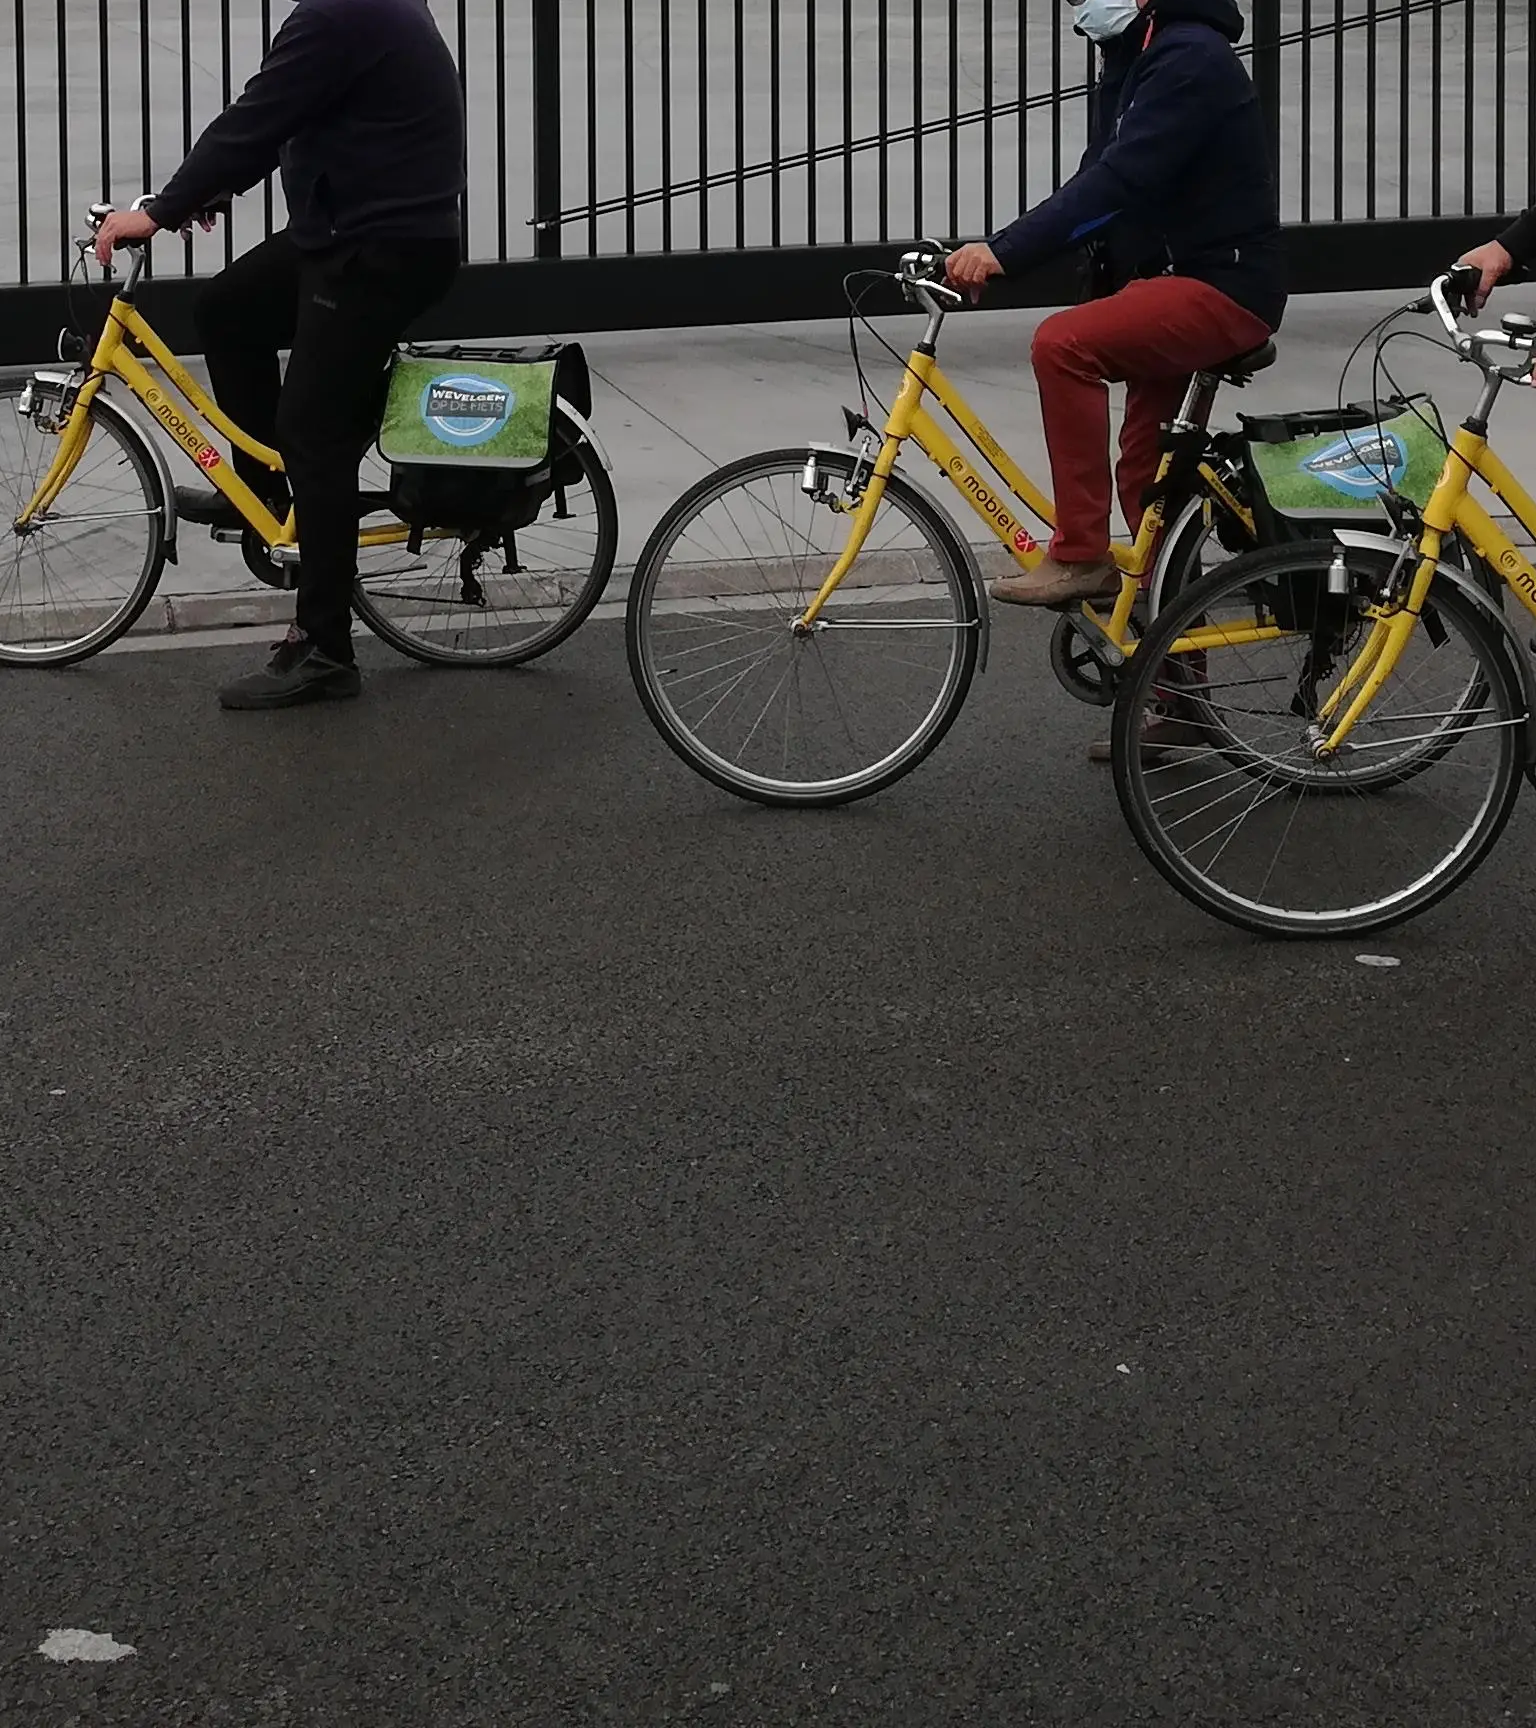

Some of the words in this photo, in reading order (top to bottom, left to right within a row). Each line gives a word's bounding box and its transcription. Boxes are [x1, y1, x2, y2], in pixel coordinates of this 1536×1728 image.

[430, 400, 448, 411] OP
[432, 389, 505, 402] WEVELGEM
[158, 404, 204, 452] mobiel
[963, 475, 1015, 533] mobiel
